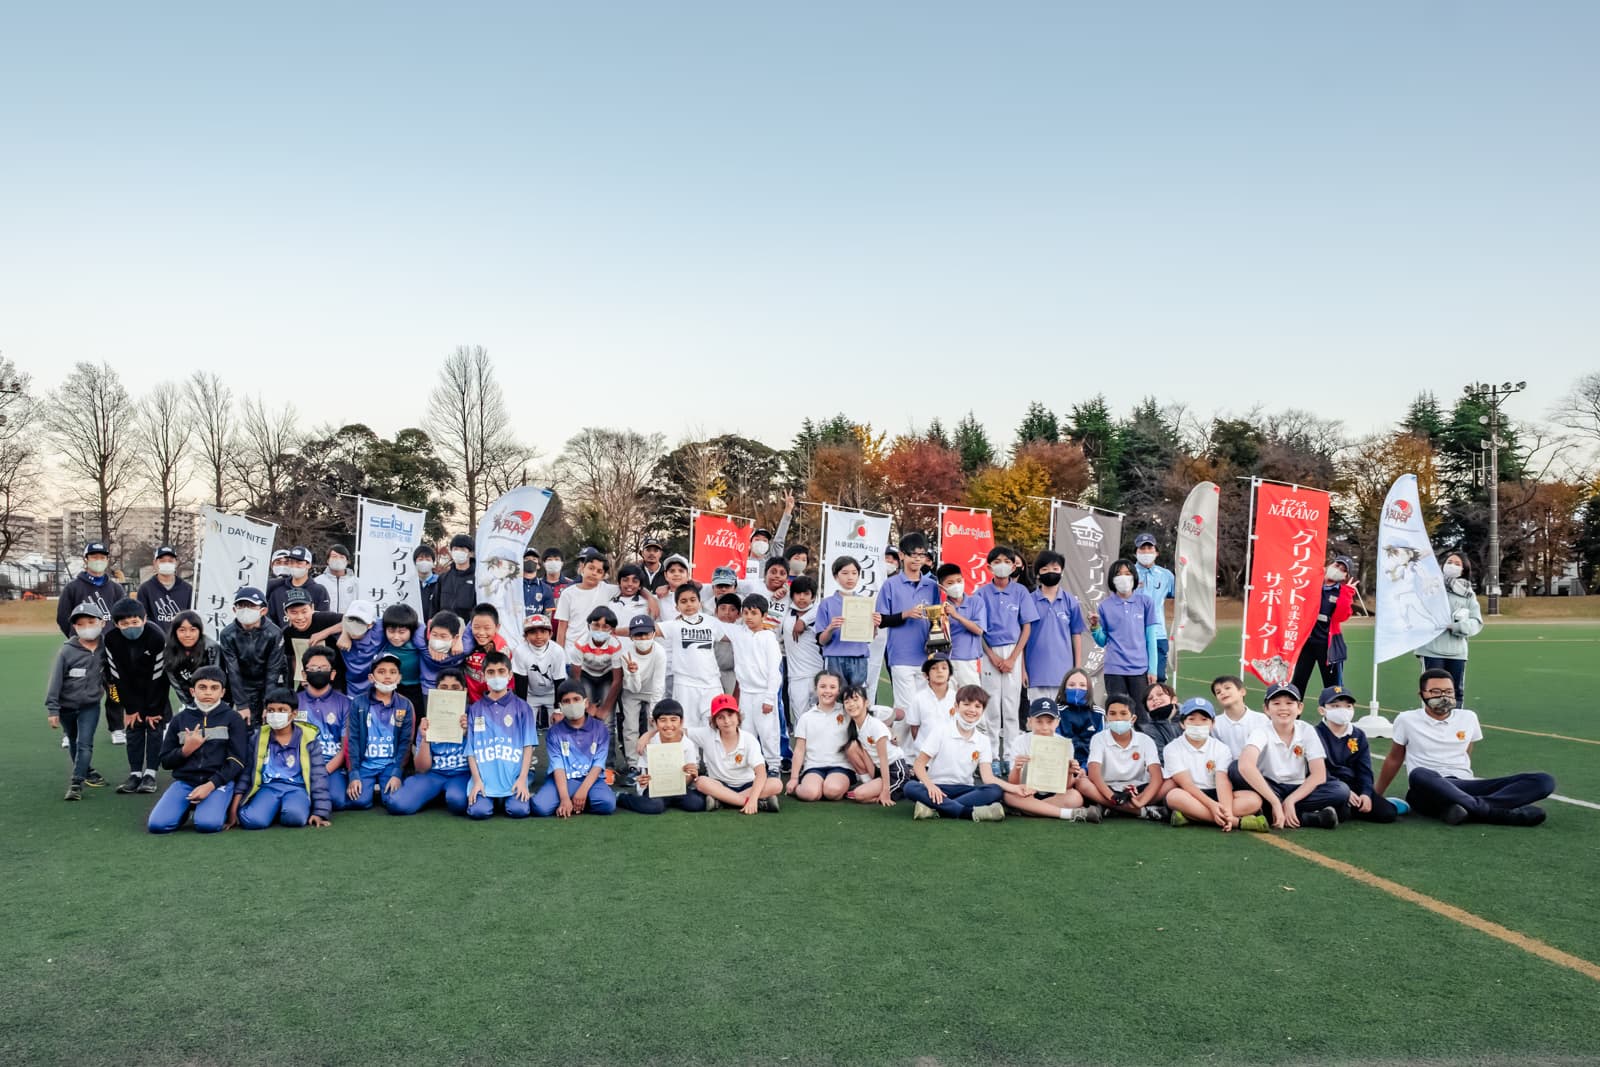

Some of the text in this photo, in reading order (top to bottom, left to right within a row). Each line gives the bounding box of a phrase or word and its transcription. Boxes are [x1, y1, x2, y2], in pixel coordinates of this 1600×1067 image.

[1268, 504, 1320, 520] NAKANO
[501, 519, 531, 536] BLAST
[1258, 572, 1285, 655] サポーター
